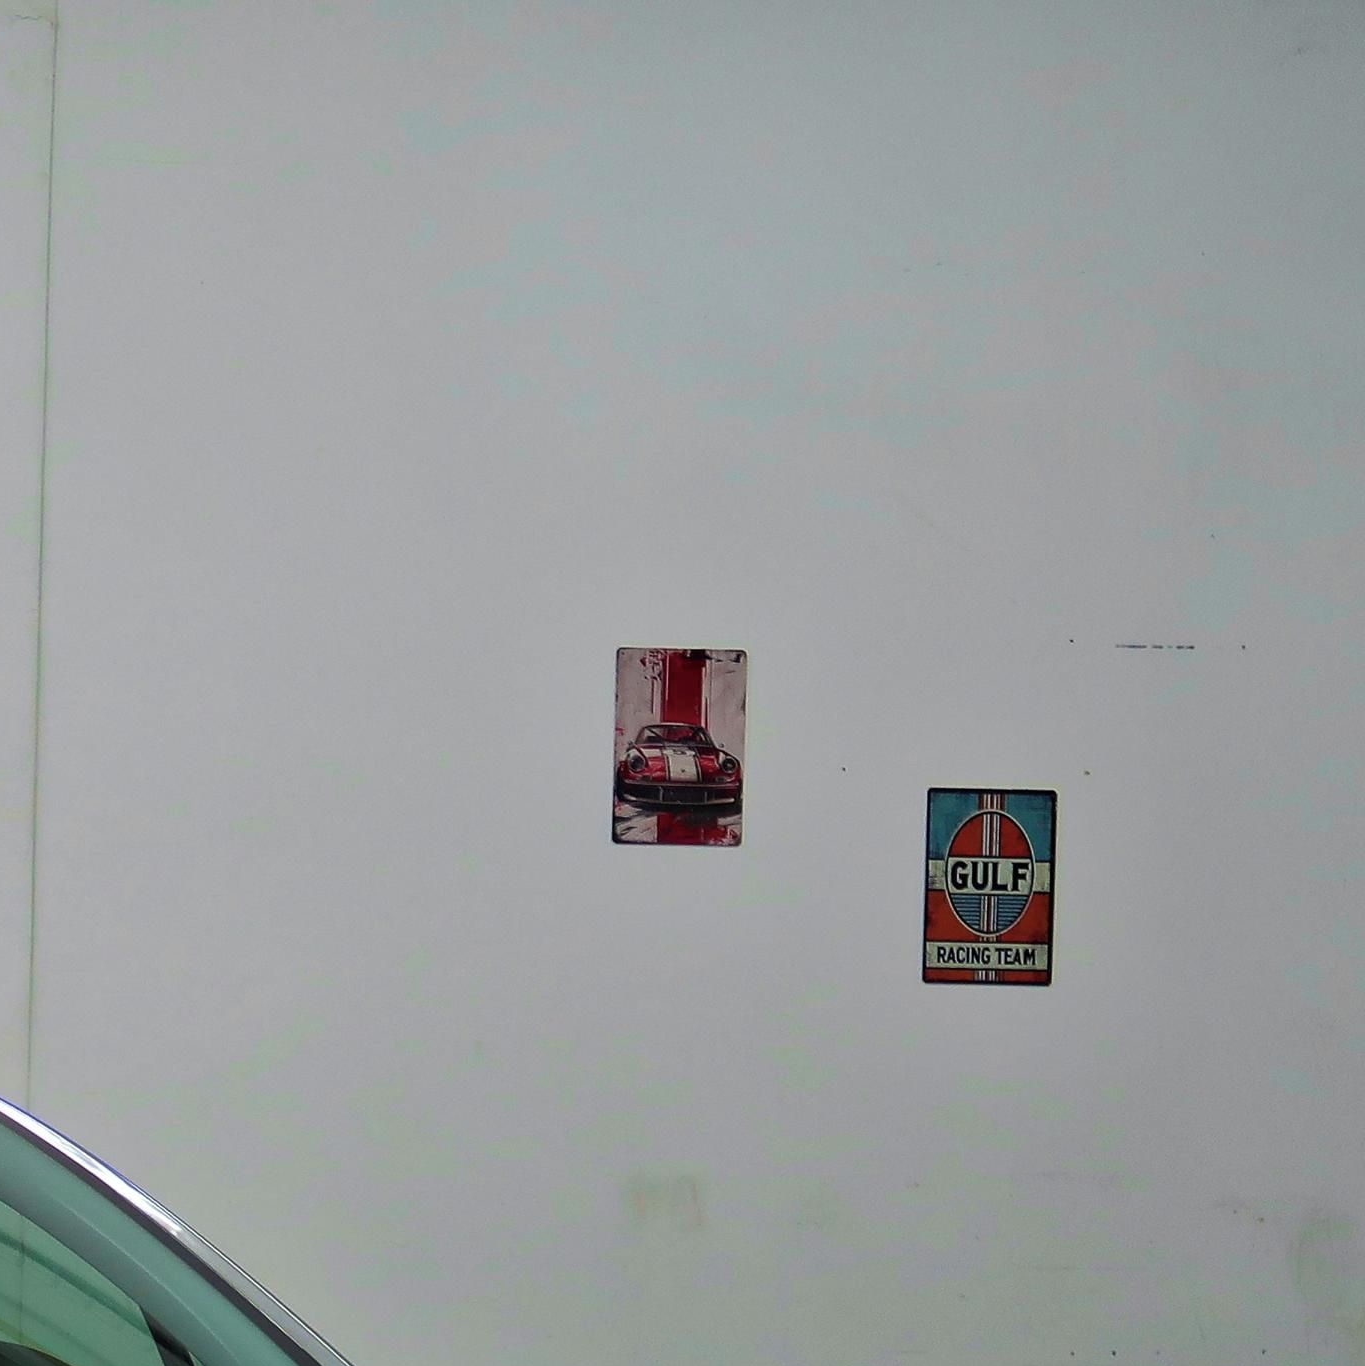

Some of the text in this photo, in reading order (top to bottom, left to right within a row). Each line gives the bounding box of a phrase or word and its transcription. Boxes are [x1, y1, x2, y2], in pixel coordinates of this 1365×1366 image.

[950, 860, 1029, 892] GULF
[937, 946, 1036, 966] RACING TEAM
